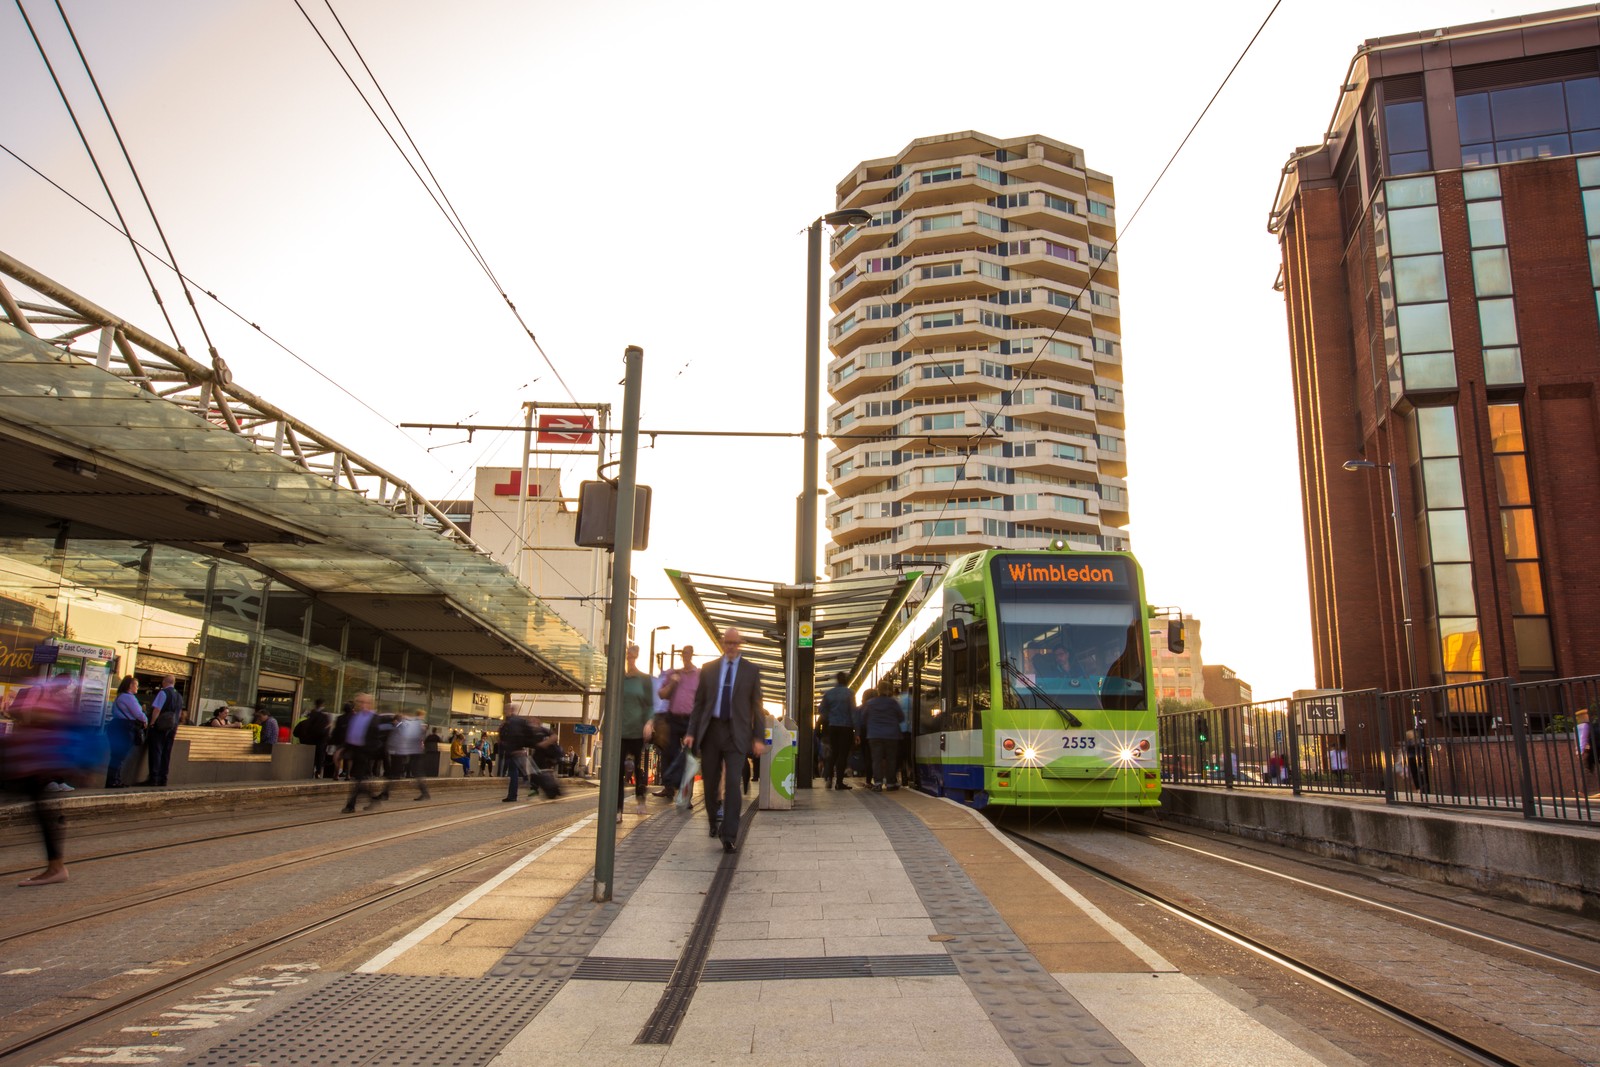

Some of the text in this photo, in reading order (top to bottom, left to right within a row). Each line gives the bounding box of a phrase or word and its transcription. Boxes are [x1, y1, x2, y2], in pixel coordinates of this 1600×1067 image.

[1008, 562, 1114, 582] Wimbledon
[64, 644, 97, 655] East Croydon
[1062, 736, 1096, 749] 2553
